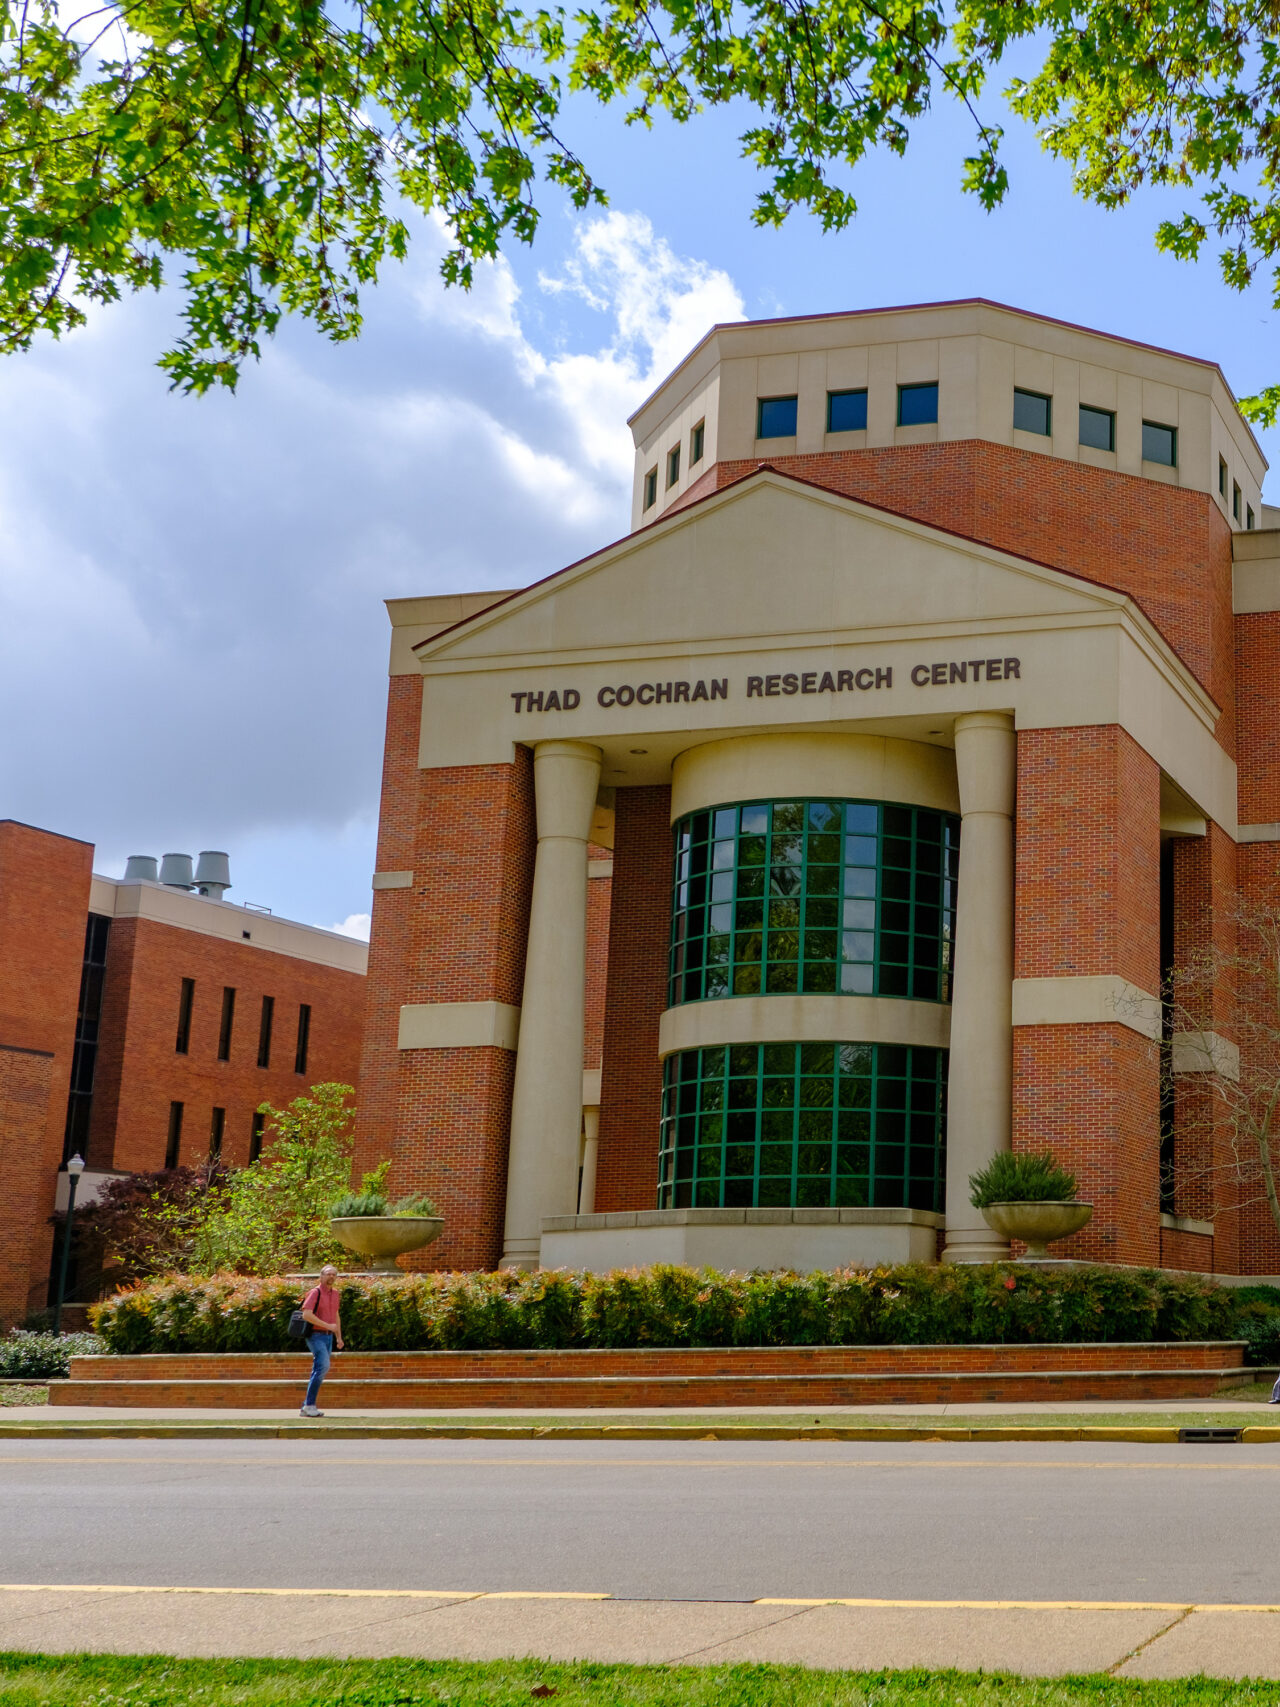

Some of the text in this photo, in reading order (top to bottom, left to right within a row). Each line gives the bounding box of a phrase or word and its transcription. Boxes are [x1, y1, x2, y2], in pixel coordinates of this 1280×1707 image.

[511, 657, 1021, 713] THAD COCHRAN RESEARCH CENTER
